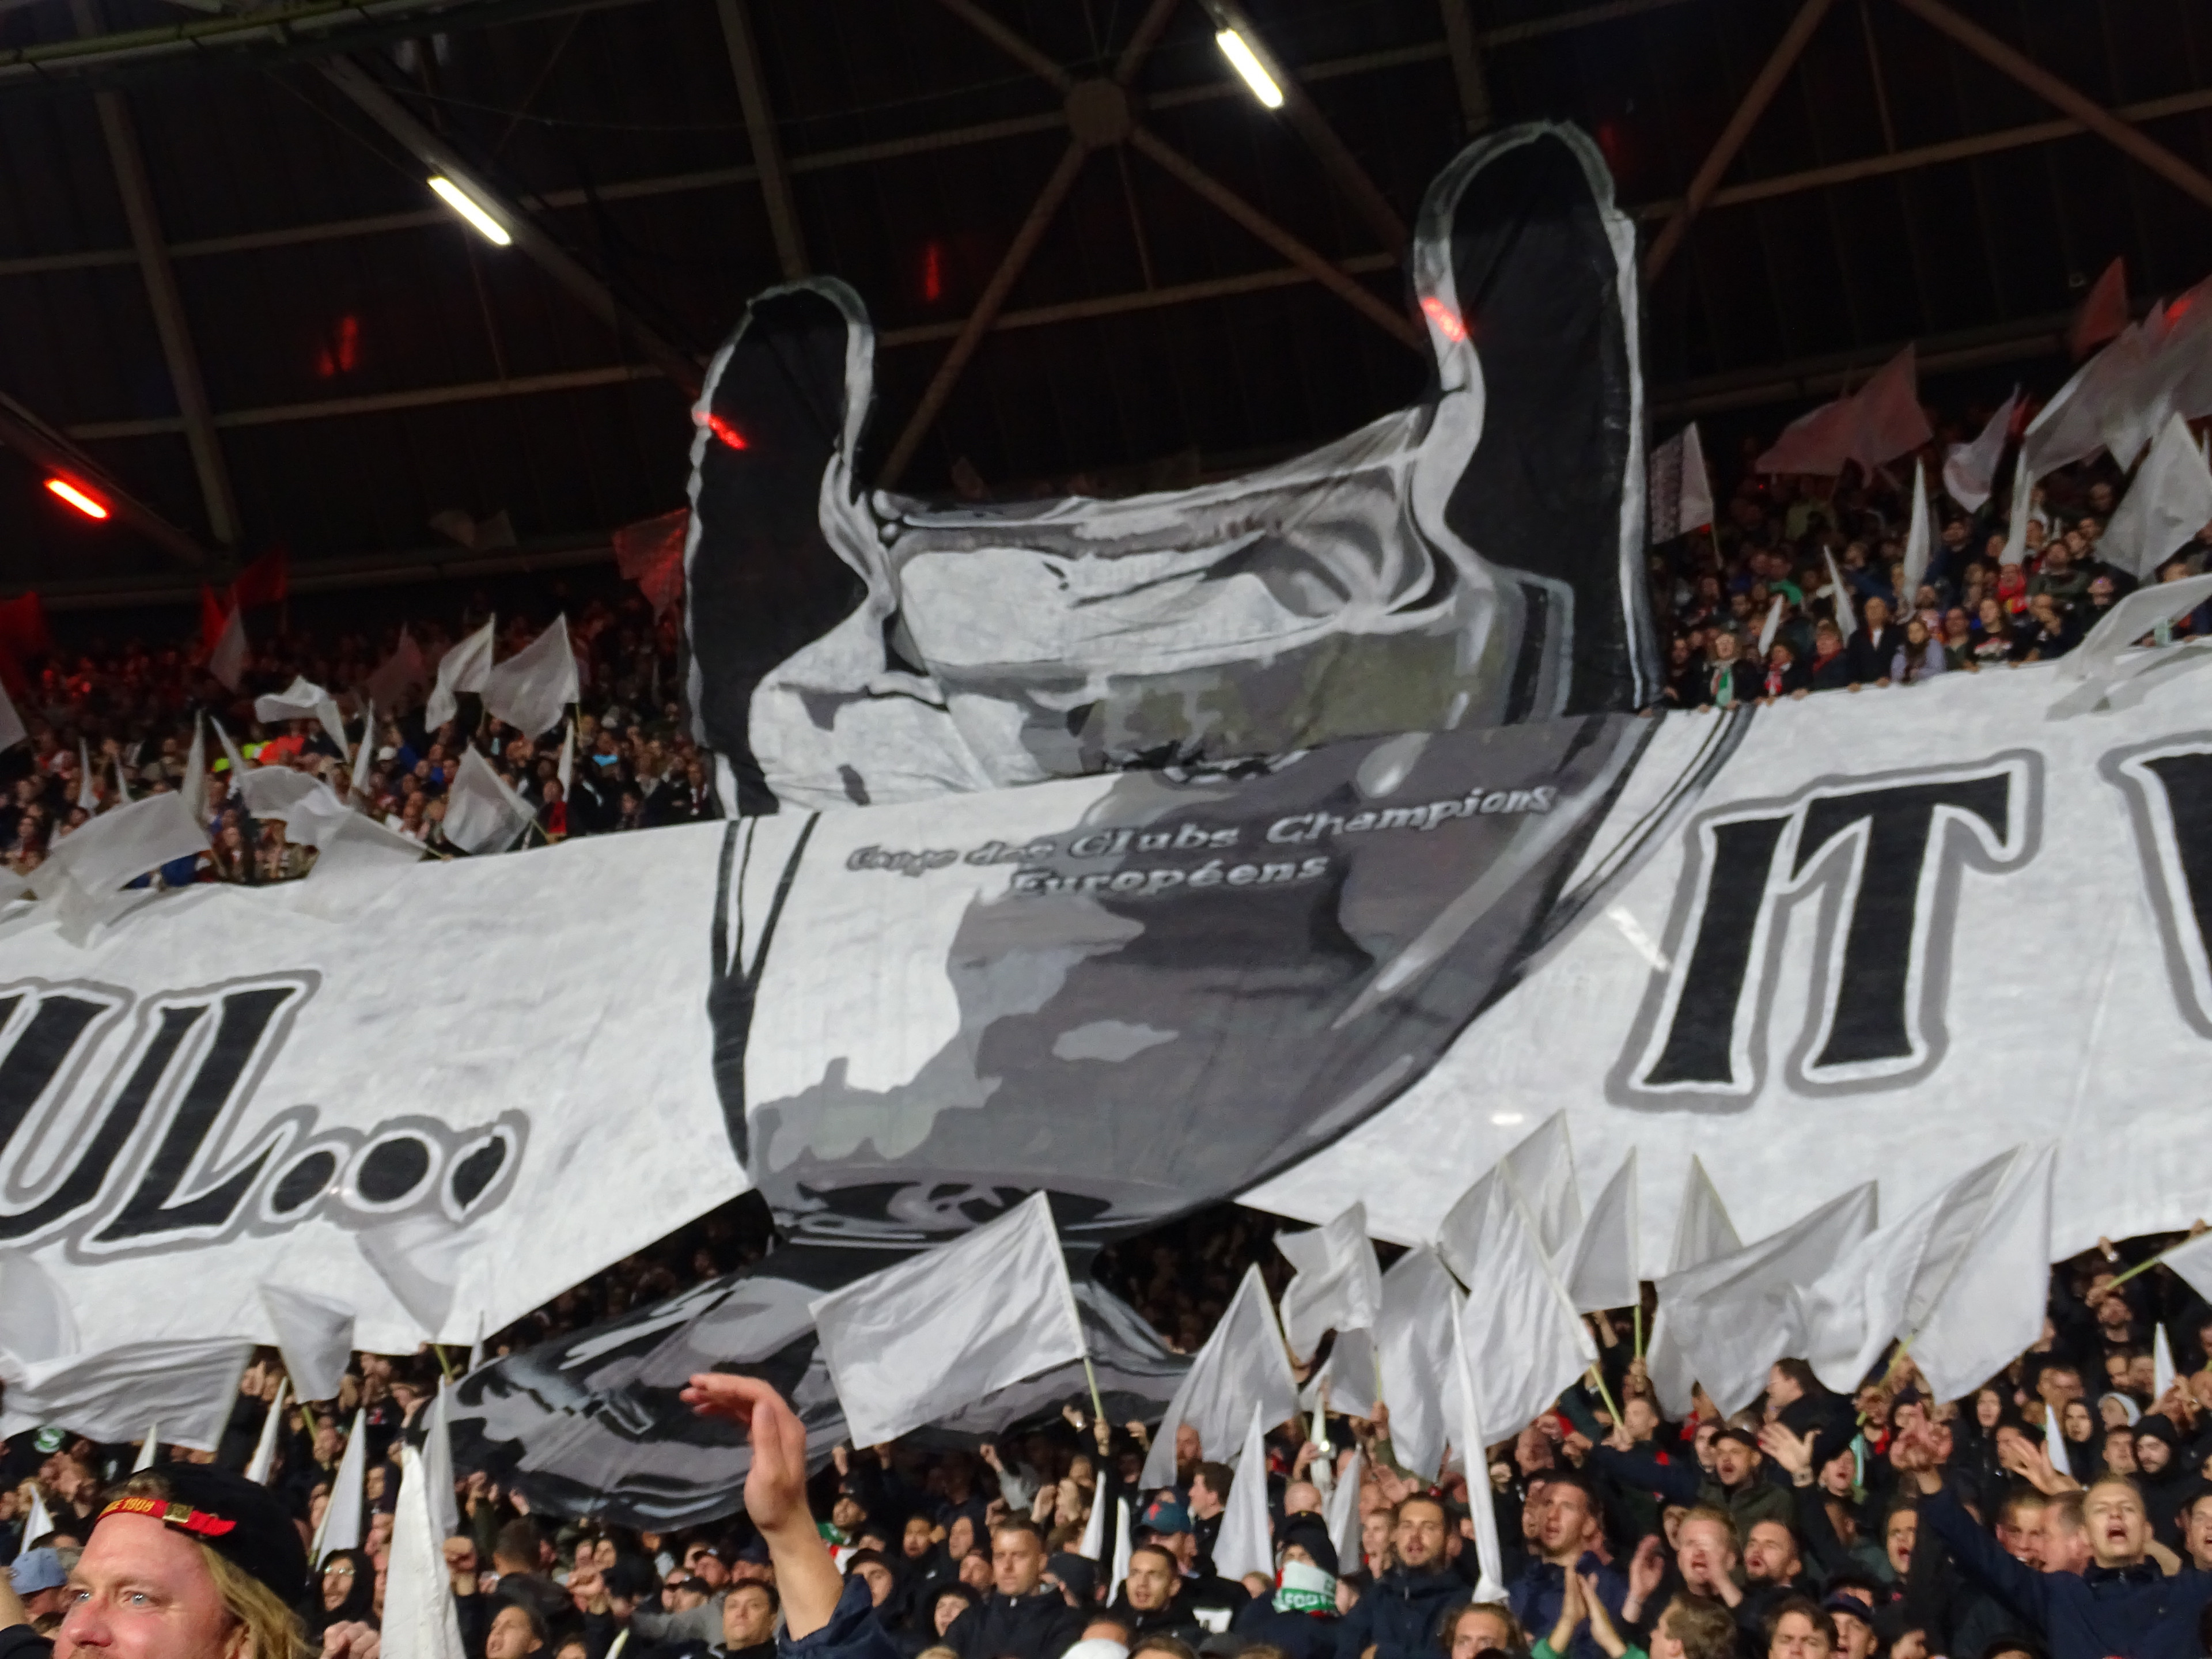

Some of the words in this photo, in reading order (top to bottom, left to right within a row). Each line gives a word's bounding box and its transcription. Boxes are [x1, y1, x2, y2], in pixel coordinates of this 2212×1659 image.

[1070, 824, 1241, 857] Clubs
[1267, 786, 1556, 843] Champions
[1611, 753, 2039, 1108] IT
